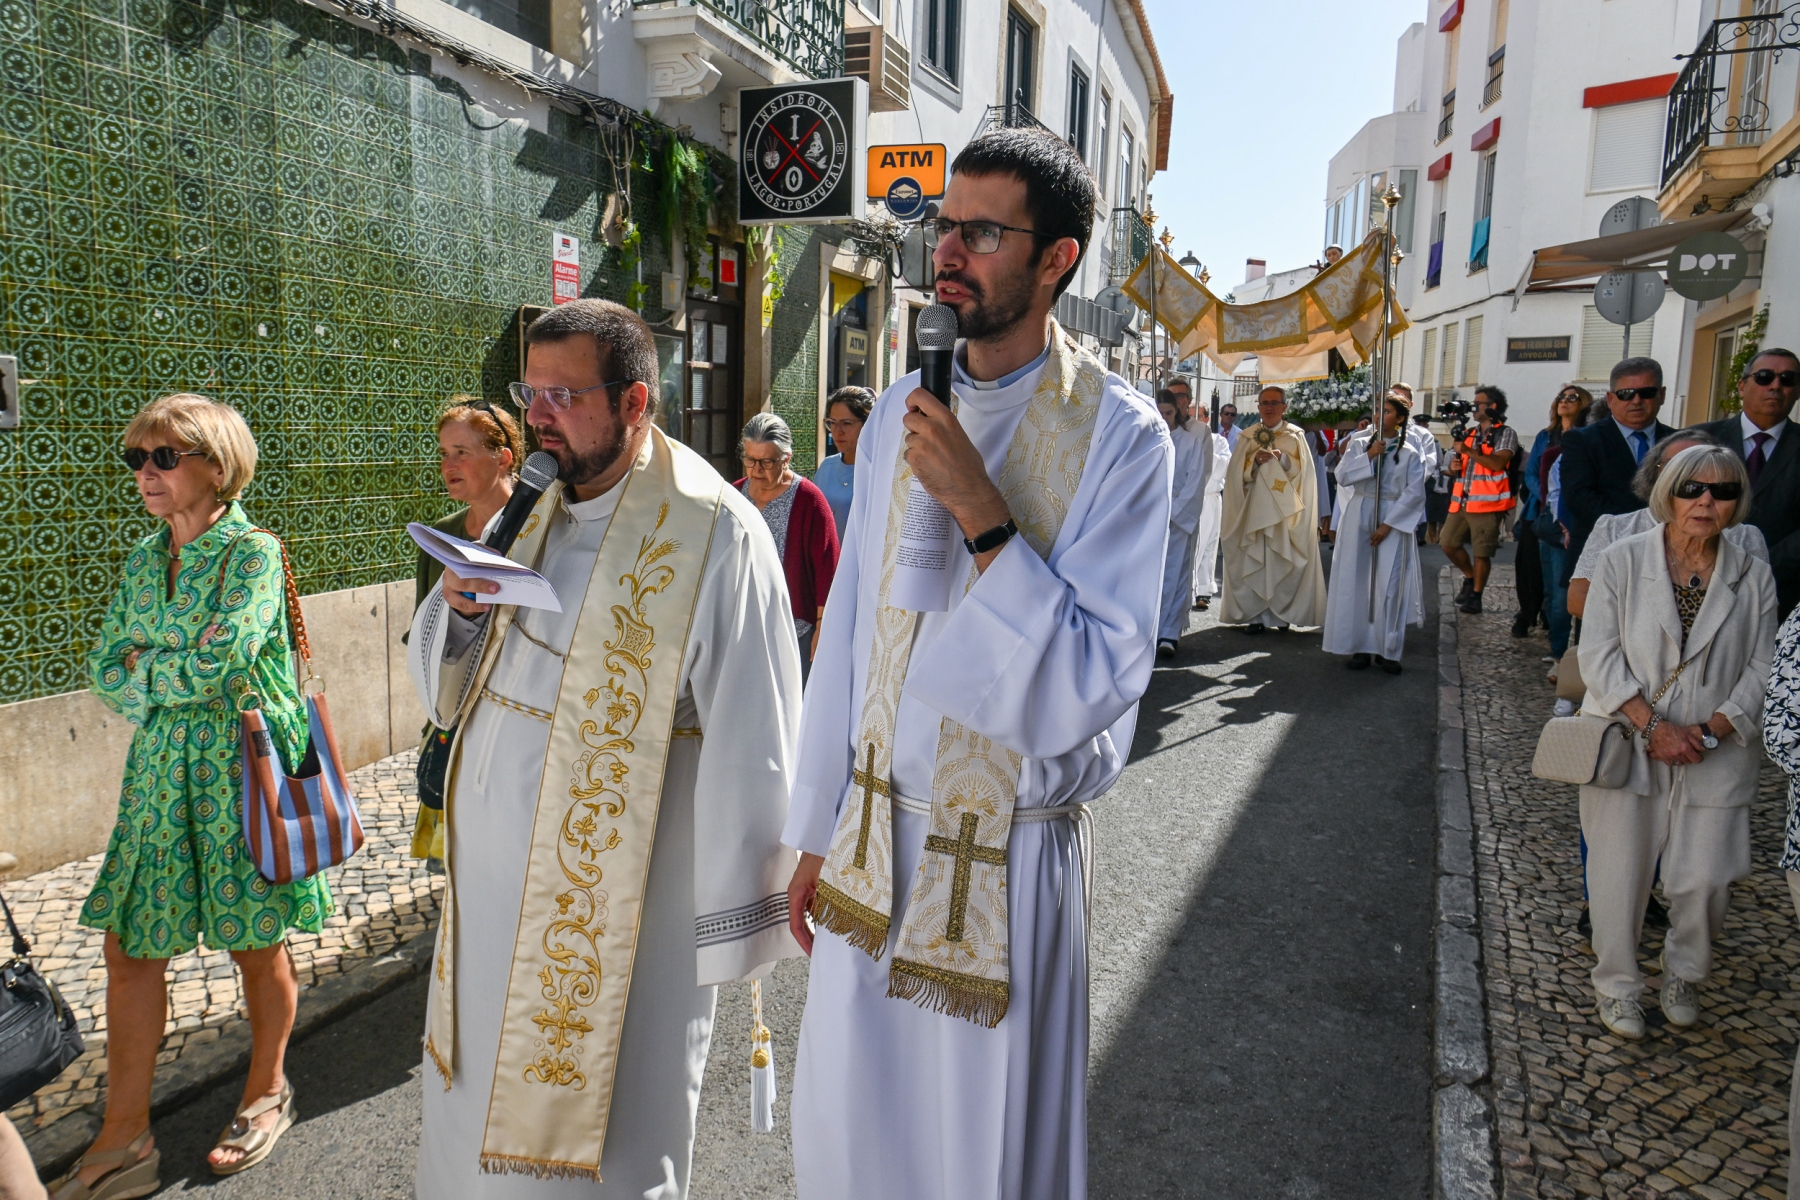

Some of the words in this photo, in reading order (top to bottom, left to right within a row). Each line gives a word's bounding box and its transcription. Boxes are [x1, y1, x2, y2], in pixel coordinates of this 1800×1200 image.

[755, 93, 836, 128] INSIDEOUT
[880, 150, 933, 168] ATM
[749, 173, 780, 207] LAGOS
[787, 162, 843, 211] PORTUGAL
[555, 263, 578, 277] Alarme
[1679, 254, 1736, 275] DOT
[849, 336, 864, 351] ATM
[1518, 351, 1558, 359] ADVOGADA
